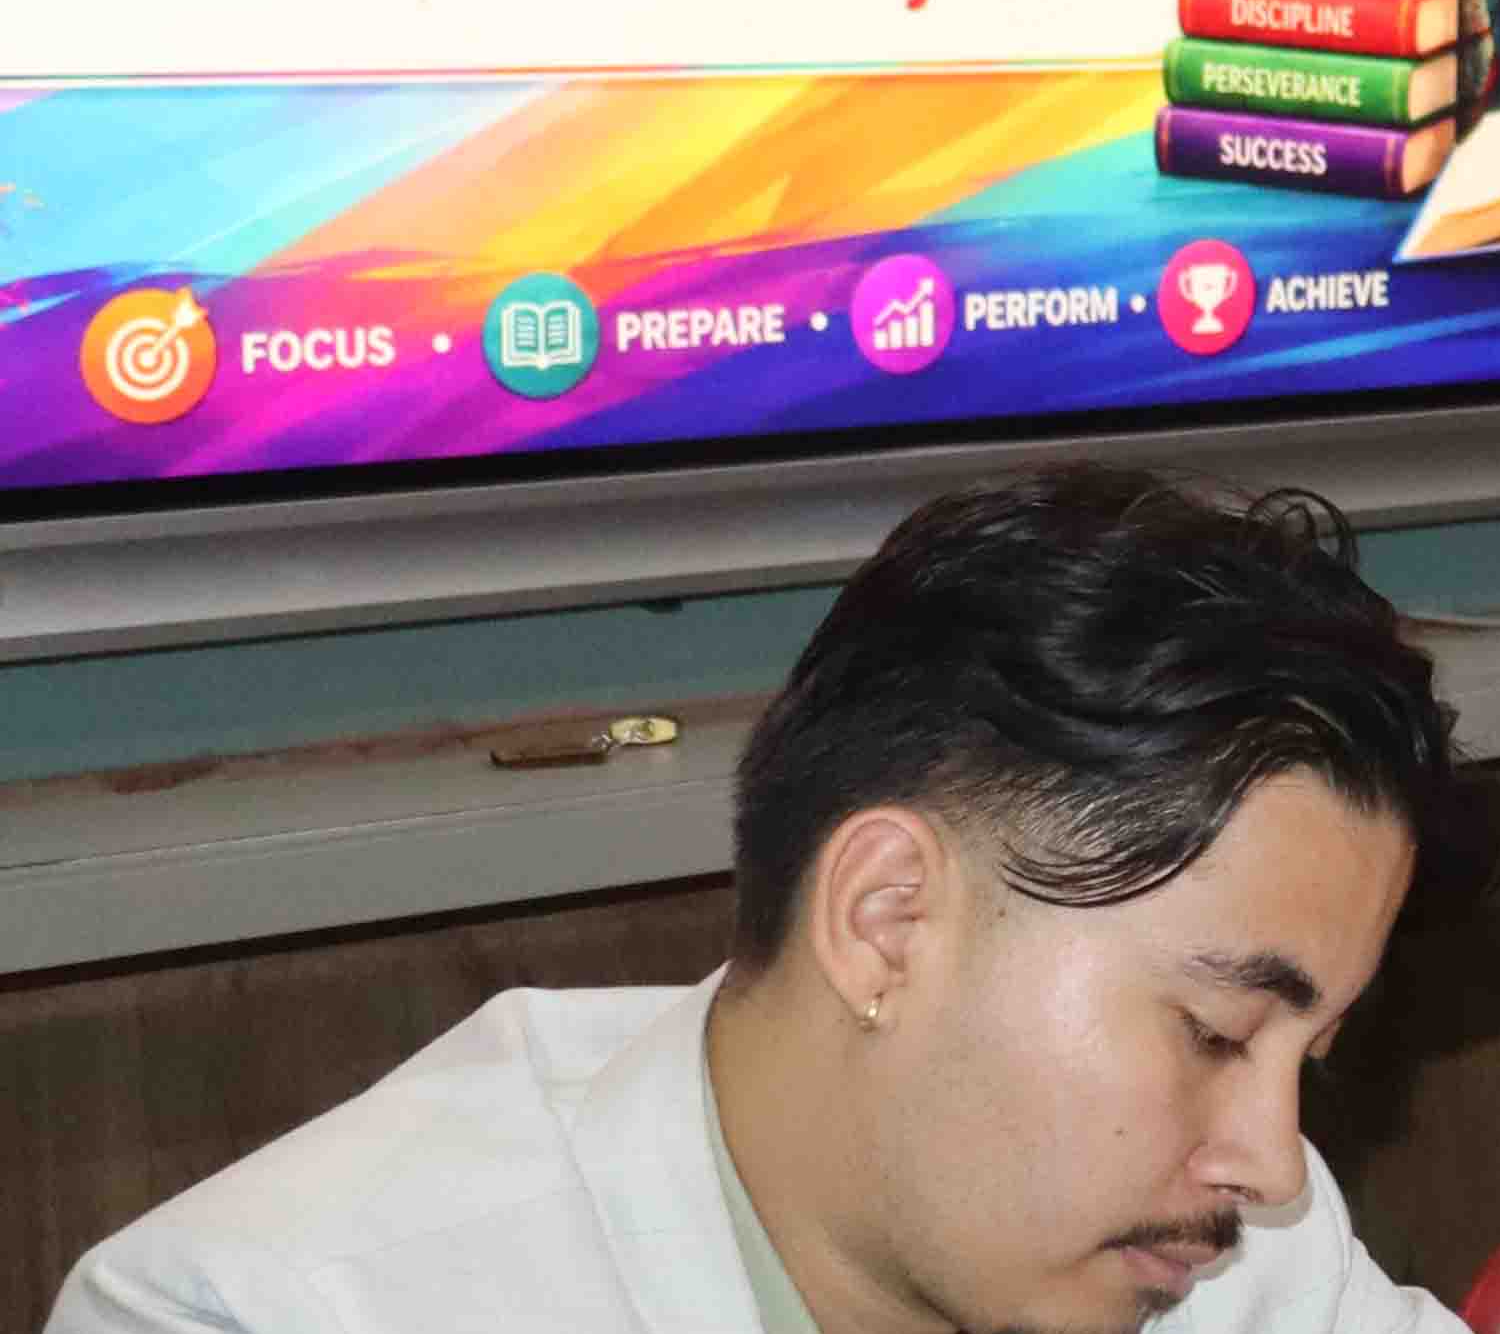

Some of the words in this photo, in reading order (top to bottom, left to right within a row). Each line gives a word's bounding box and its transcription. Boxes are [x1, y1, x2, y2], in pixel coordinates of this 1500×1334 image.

[1202, 62, 1360, 108] PERSEVERANCE
[1220, 135, 1326, 174] SUCCESS
[241, 327, 394, 376] FOCUS
[616, 305, 785, 351] PREPARE
[965, 287, 1118, 330] PERFORM
[1266, 273, 1388, 313] ACHIEVE
